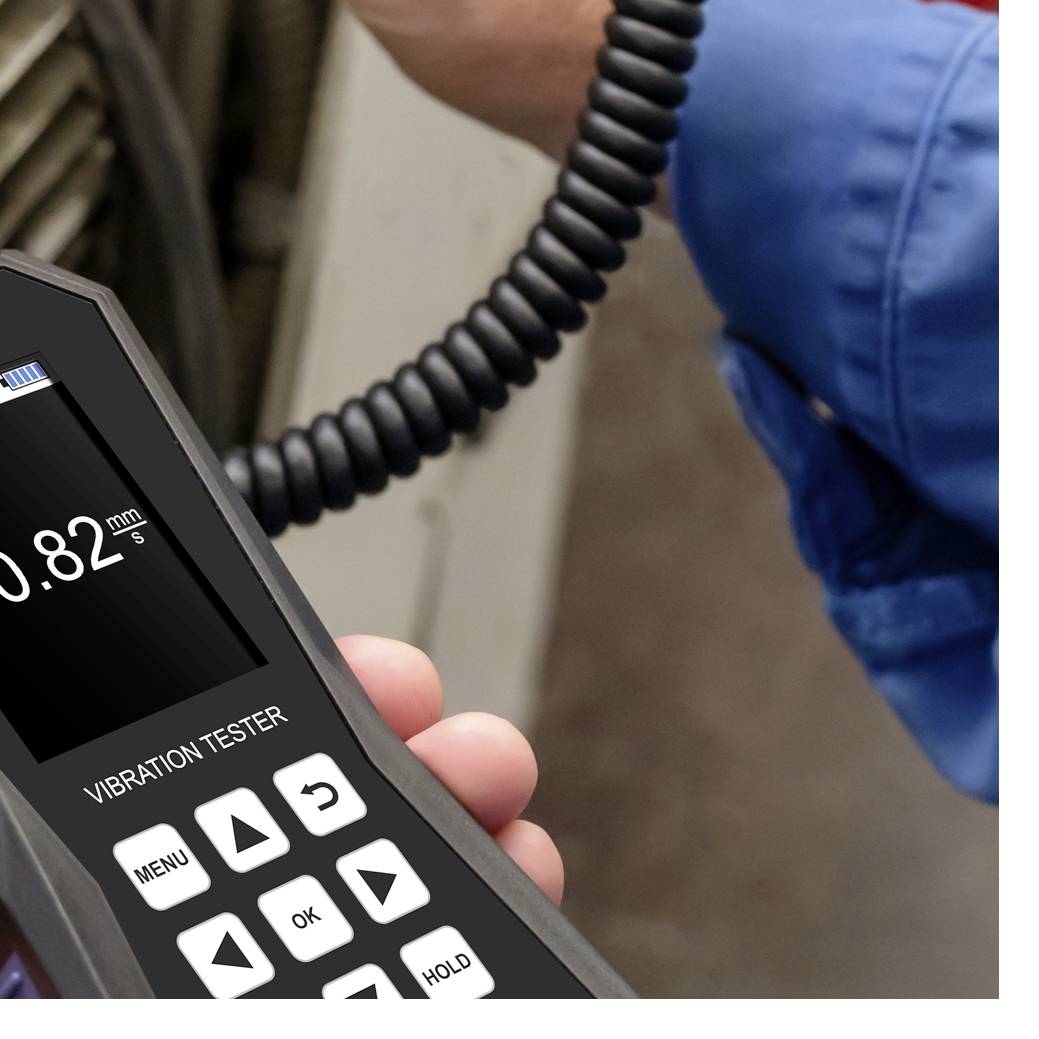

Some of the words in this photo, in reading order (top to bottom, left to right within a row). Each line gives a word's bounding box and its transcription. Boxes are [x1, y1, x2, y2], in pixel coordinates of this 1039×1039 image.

[105, 507, 142, 531] mm
[83, 741, 204, 804] VIBRATION
[199, 706, 289, 754] TESTER
[133, 849, 189, 885] MENU
[291, 906, 322, 929] OK
[421, 953, 471, 986] HOLD
